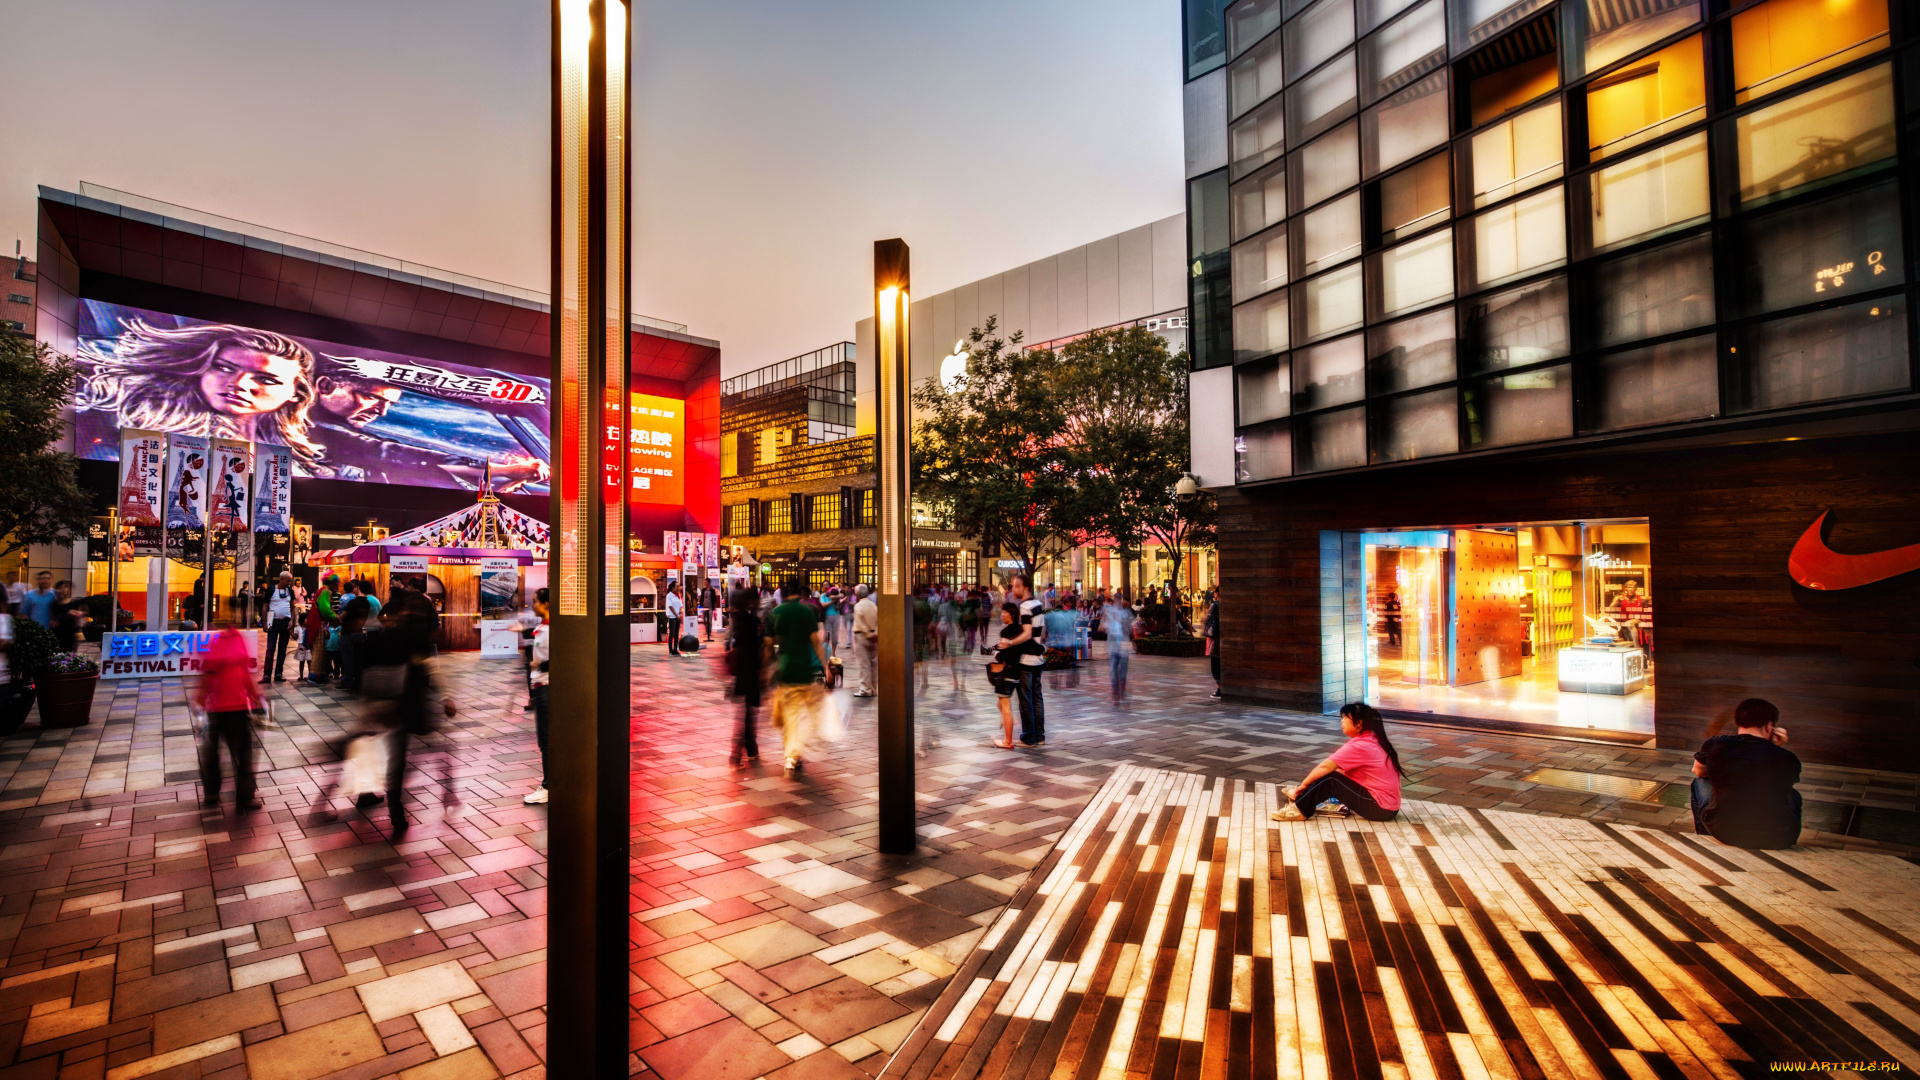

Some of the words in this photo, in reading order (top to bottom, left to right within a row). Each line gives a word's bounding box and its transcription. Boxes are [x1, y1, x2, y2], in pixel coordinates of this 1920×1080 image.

[147, 440, 159, 505] 法国文化节
[278, 455, 289, 515] 法国文化节
[139, 473, 147, 505] FESTIVAL
[270, 486, 278, 515] FESTIVAL
[437, 556, 465, 564] FESTIVAL
[110, 633, 220, 657] 法国文化
[102, 659, 177, 674] FESTIVAL
